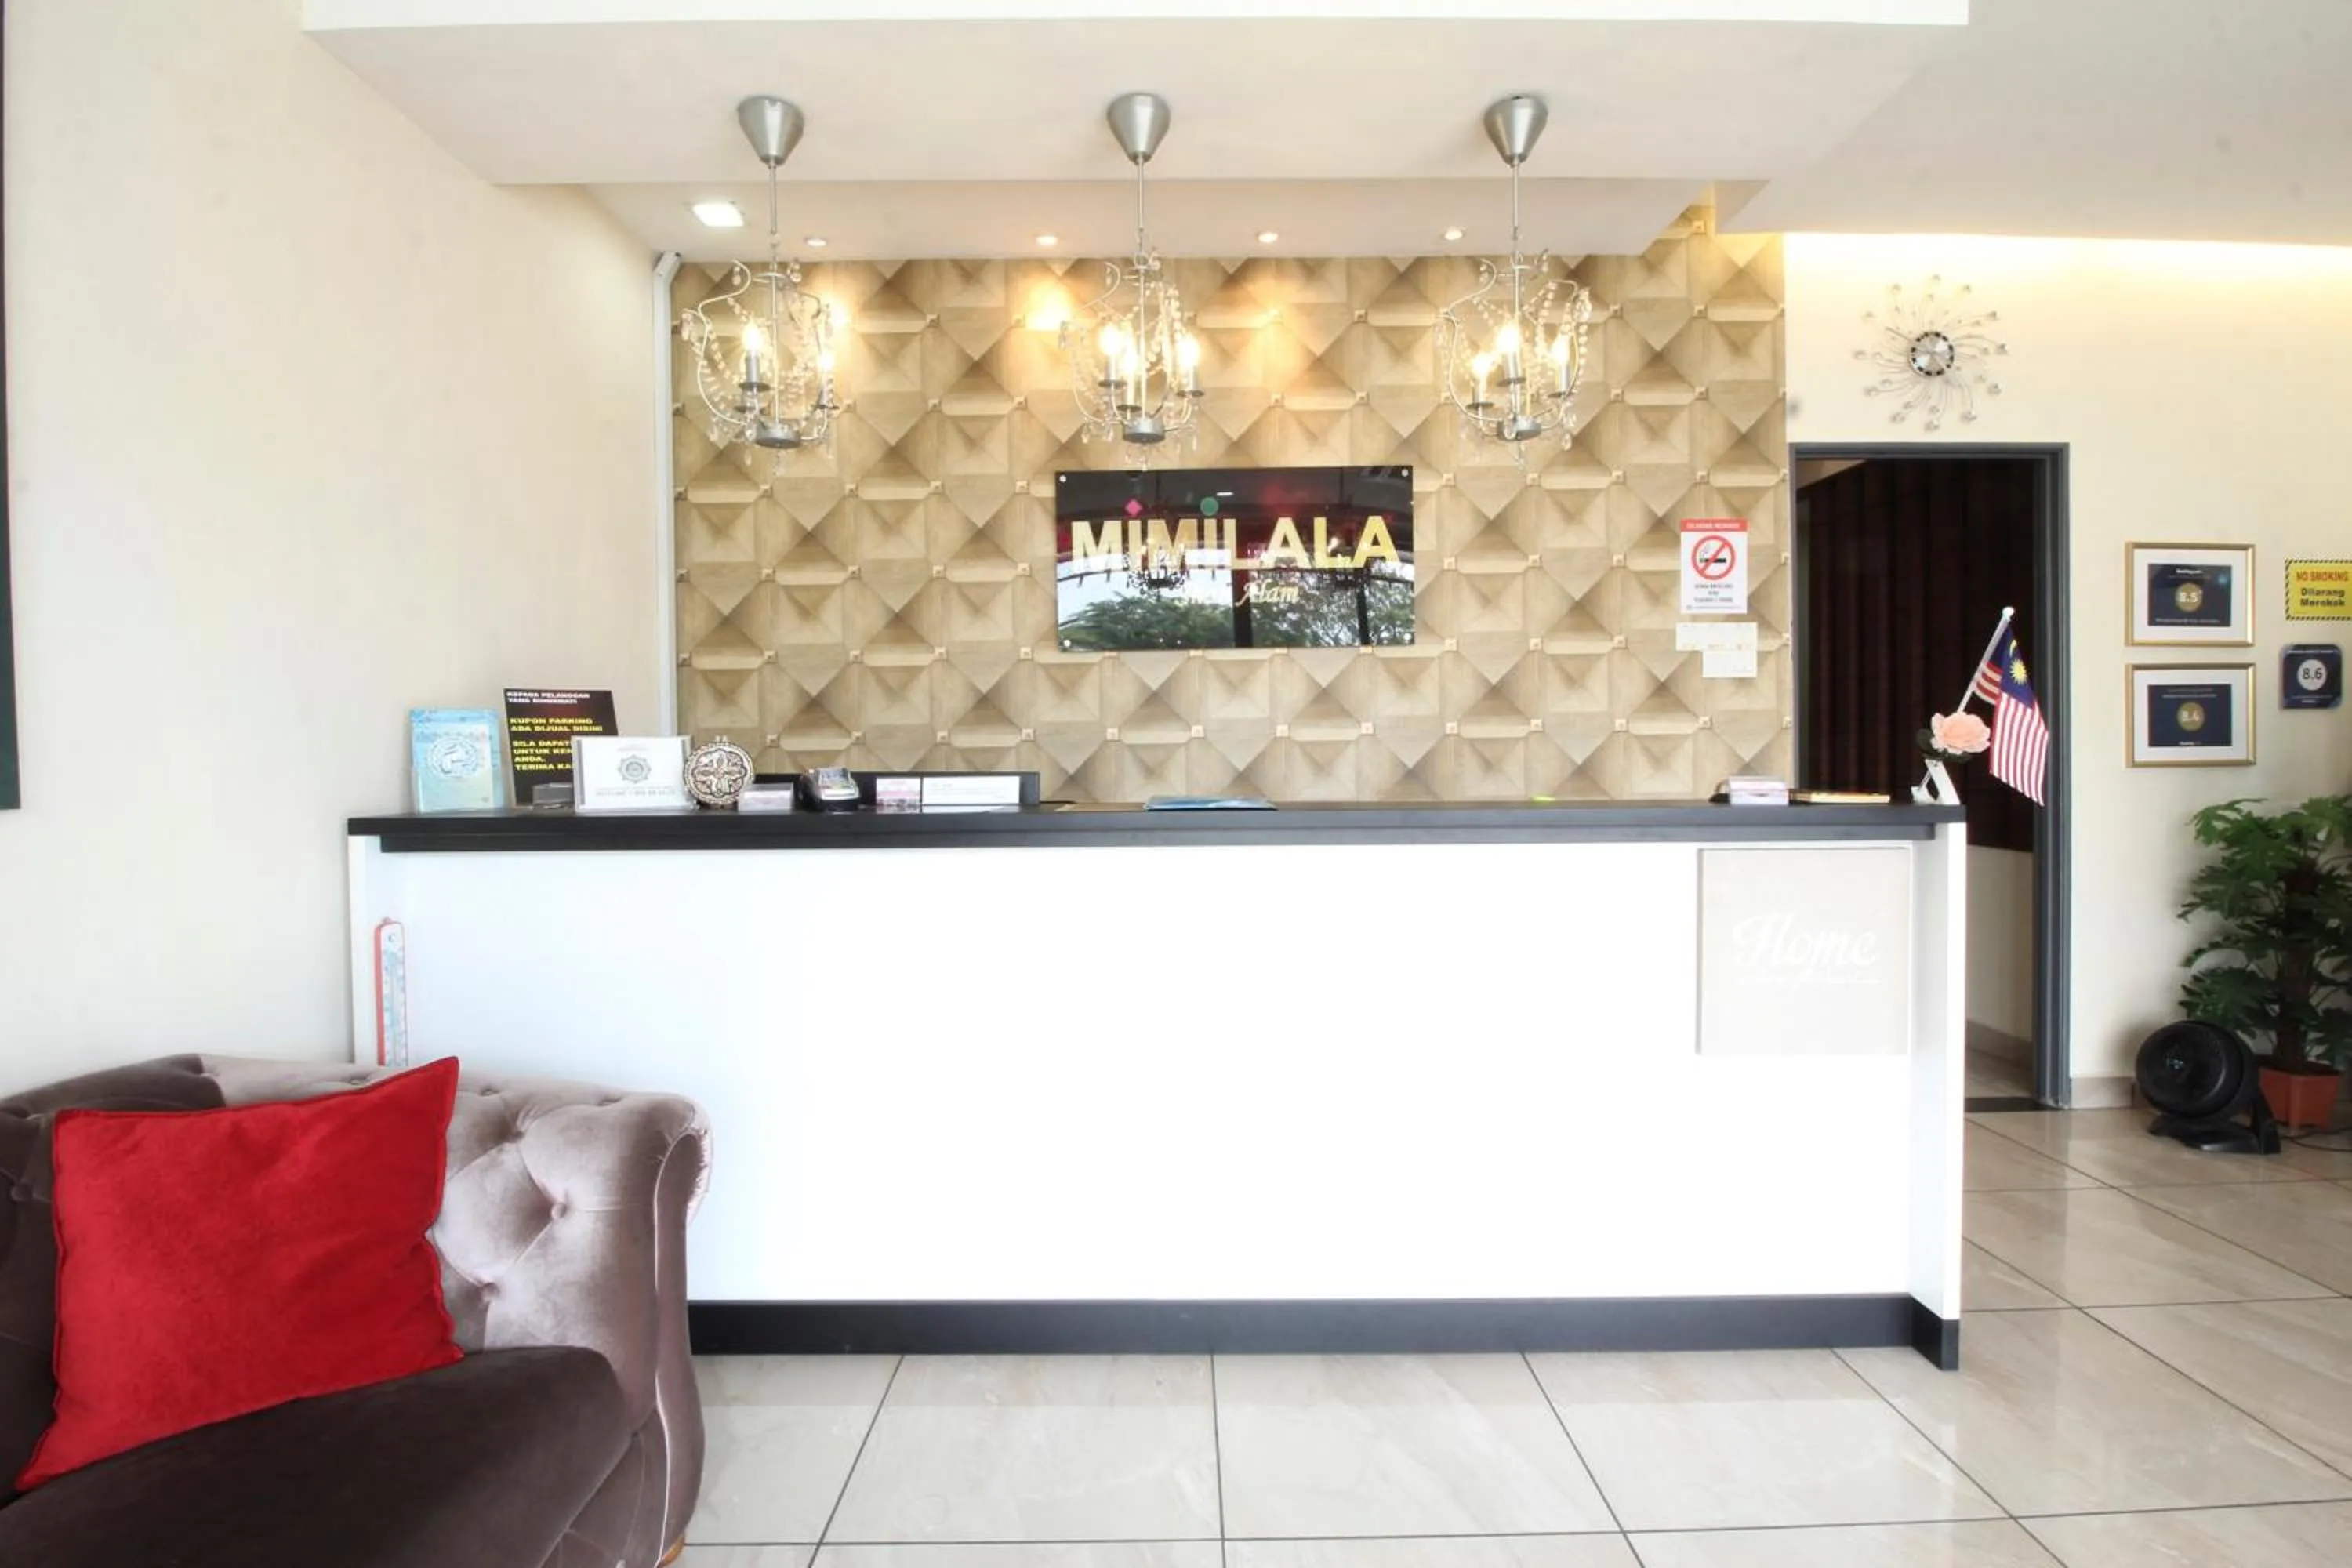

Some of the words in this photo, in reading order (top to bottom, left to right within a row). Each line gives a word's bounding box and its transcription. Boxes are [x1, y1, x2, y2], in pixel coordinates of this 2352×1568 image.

[2296, 571, 2308, 582] NO
[2310, 571, 2349, 582] SMOKING
[2300, 587, 2345, 598] Dilarang
[2300, 598, 2345, 607] Merokok
[2302, 667, 2322, 680] 8.6
[1731, 910, 1882, 971] Home
